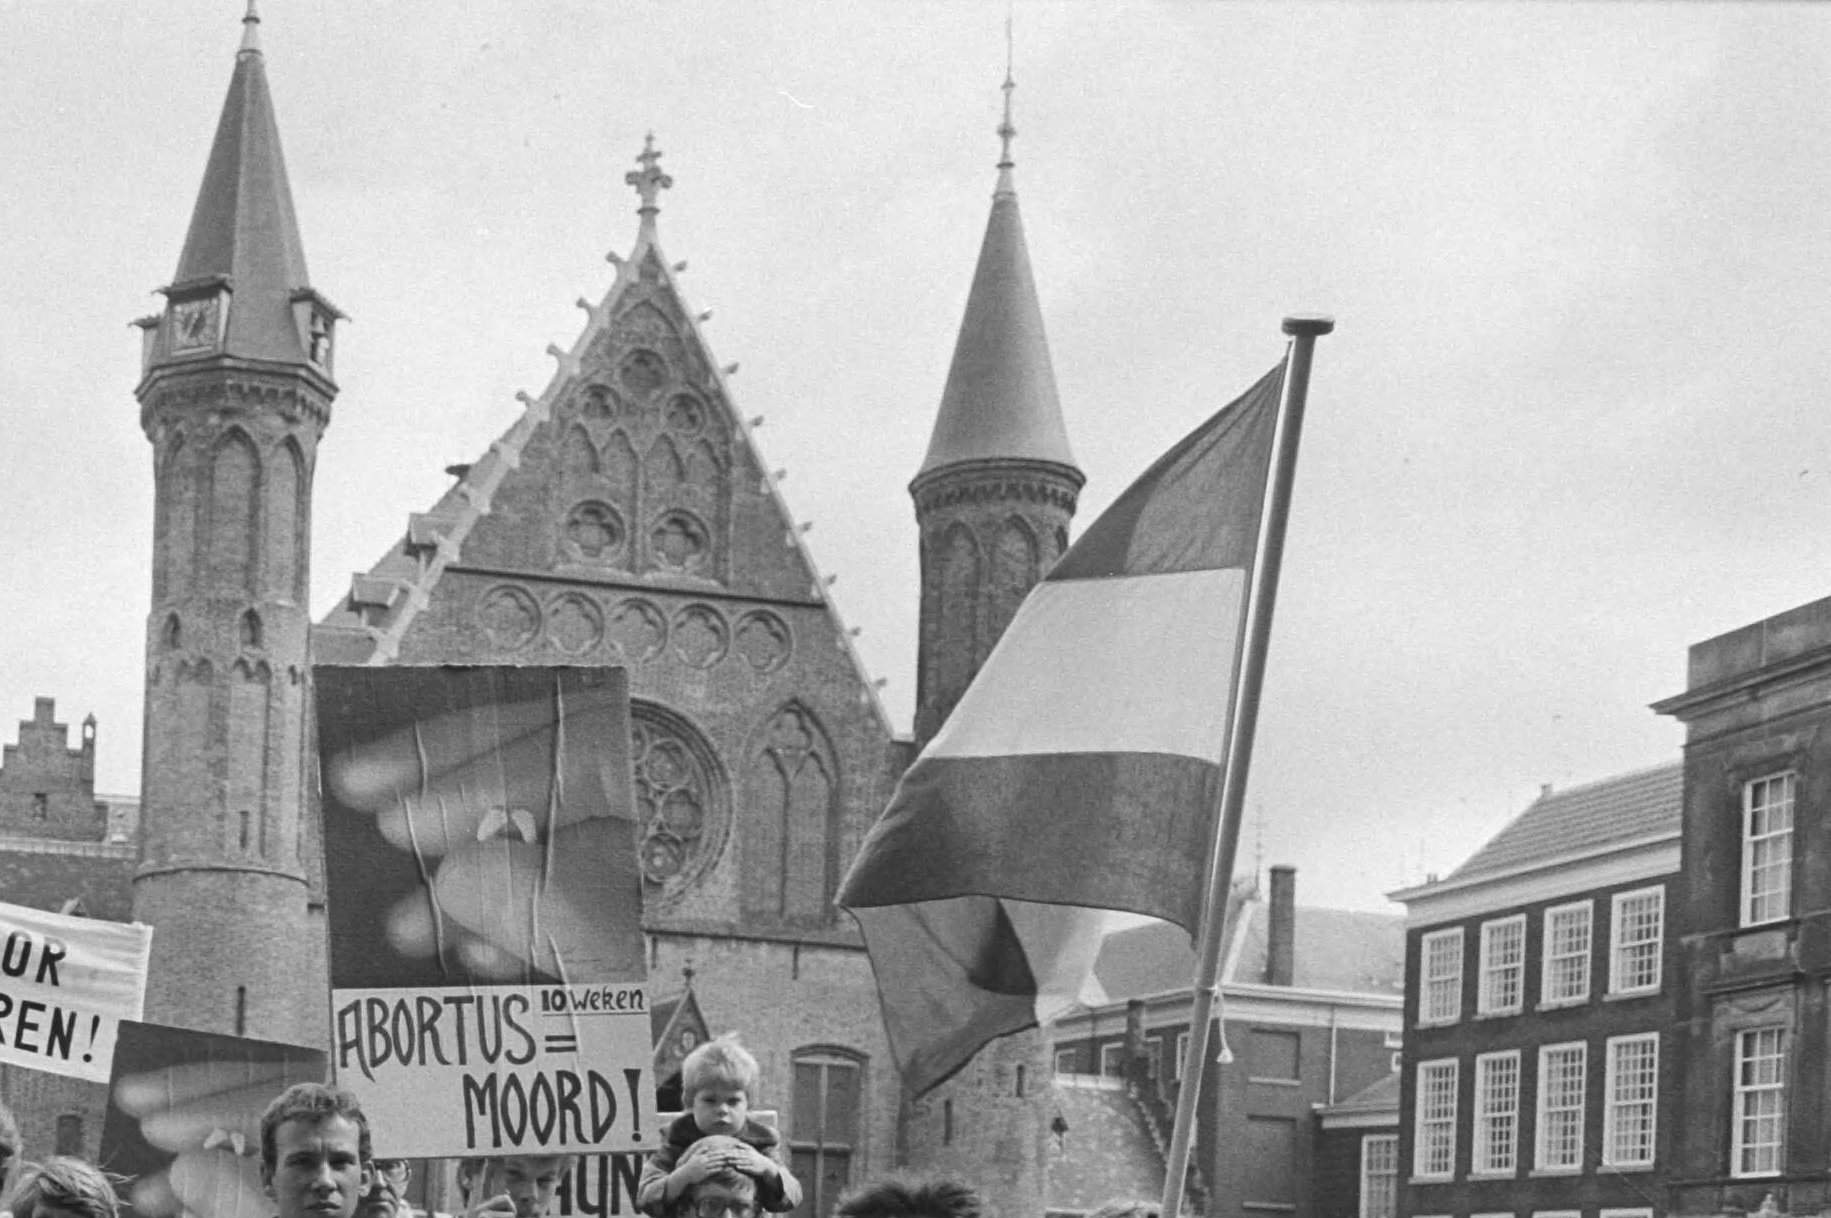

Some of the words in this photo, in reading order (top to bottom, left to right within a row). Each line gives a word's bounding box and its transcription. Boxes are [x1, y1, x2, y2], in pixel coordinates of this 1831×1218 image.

[336, 992, 538, 1083] ABORTUS
[541, 988, 567, 1013] 10
[572, 985, 645, 1012] weken
[462, 1068, 643, 1150] MOORD!
